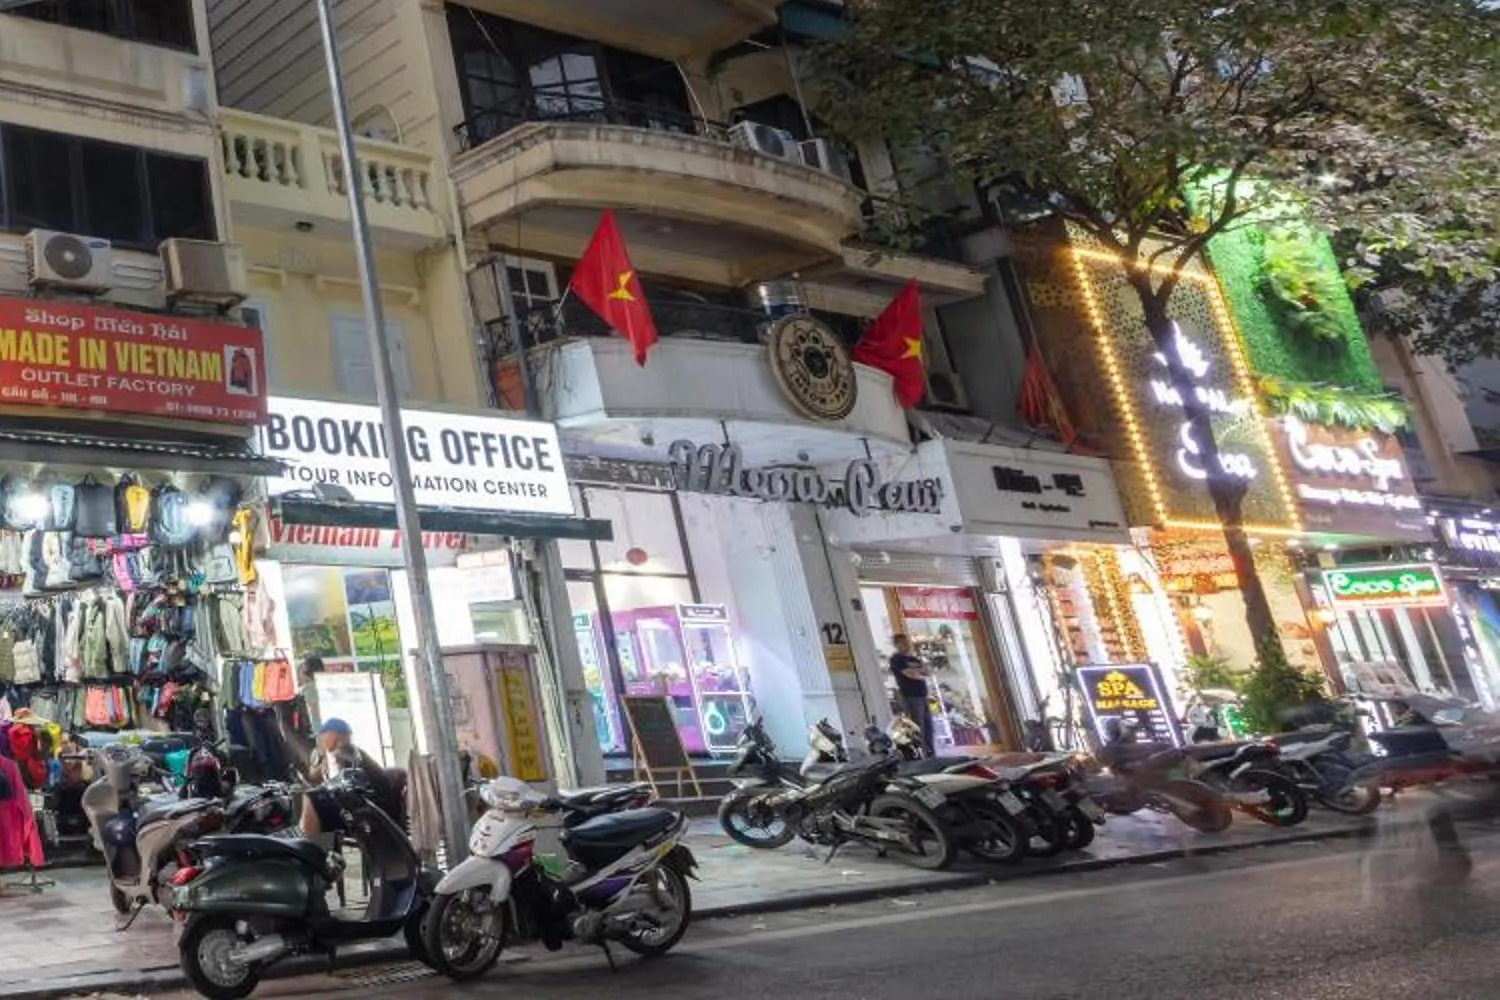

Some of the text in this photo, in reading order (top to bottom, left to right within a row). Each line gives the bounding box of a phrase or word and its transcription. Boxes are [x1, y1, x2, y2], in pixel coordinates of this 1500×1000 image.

[24, 307, 85, 330] Shop
[79, 337, 107, 371] IN
[114, 341, 222, 383] VIETNAM
[20, 367, 196, 397] OUTLET FACTORY
[267, 413, 554, 472] BOOKIG OFFICE
[289, 466, 548, 498] TOUR INFOMATION CENTER
[821, 622, 847, 645] 12
[1097, 681, 1143, 697] SPA
